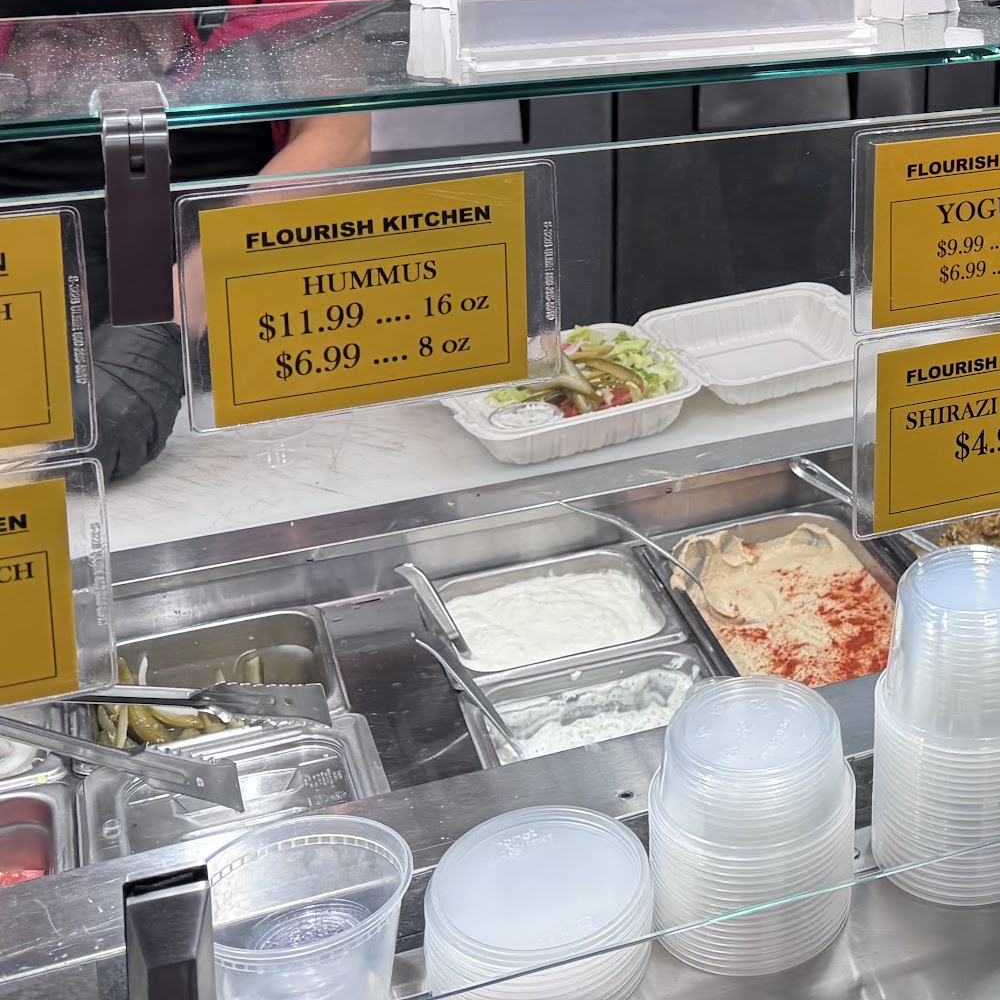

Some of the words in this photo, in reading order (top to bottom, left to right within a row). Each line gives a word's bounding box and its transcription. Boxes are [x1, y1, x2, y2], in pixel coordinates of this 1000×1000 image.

[907, 154, 999, 178] FLOURISH
[246, 219, 374, 249] FLOURISH
[383, 205, 491, 231] KITCHEN
[937, 234, 984, 258] $9.99
[303, 260, 438, 296] HUMMUS
[939, 260, 986, 284] $6.99
[258, 302, 364, 342] $11.99
[423, 293, 452, 317] 16
[460, 293, 490, 312] oz
[275, 342, 362, 381] $6.99
[418, 336, 433, 358] 8
[441, 335, 471, 353] oz
[906, 356, 997, 383] FLOURISH
[905, 397, 998, 430] SHIRAZI
